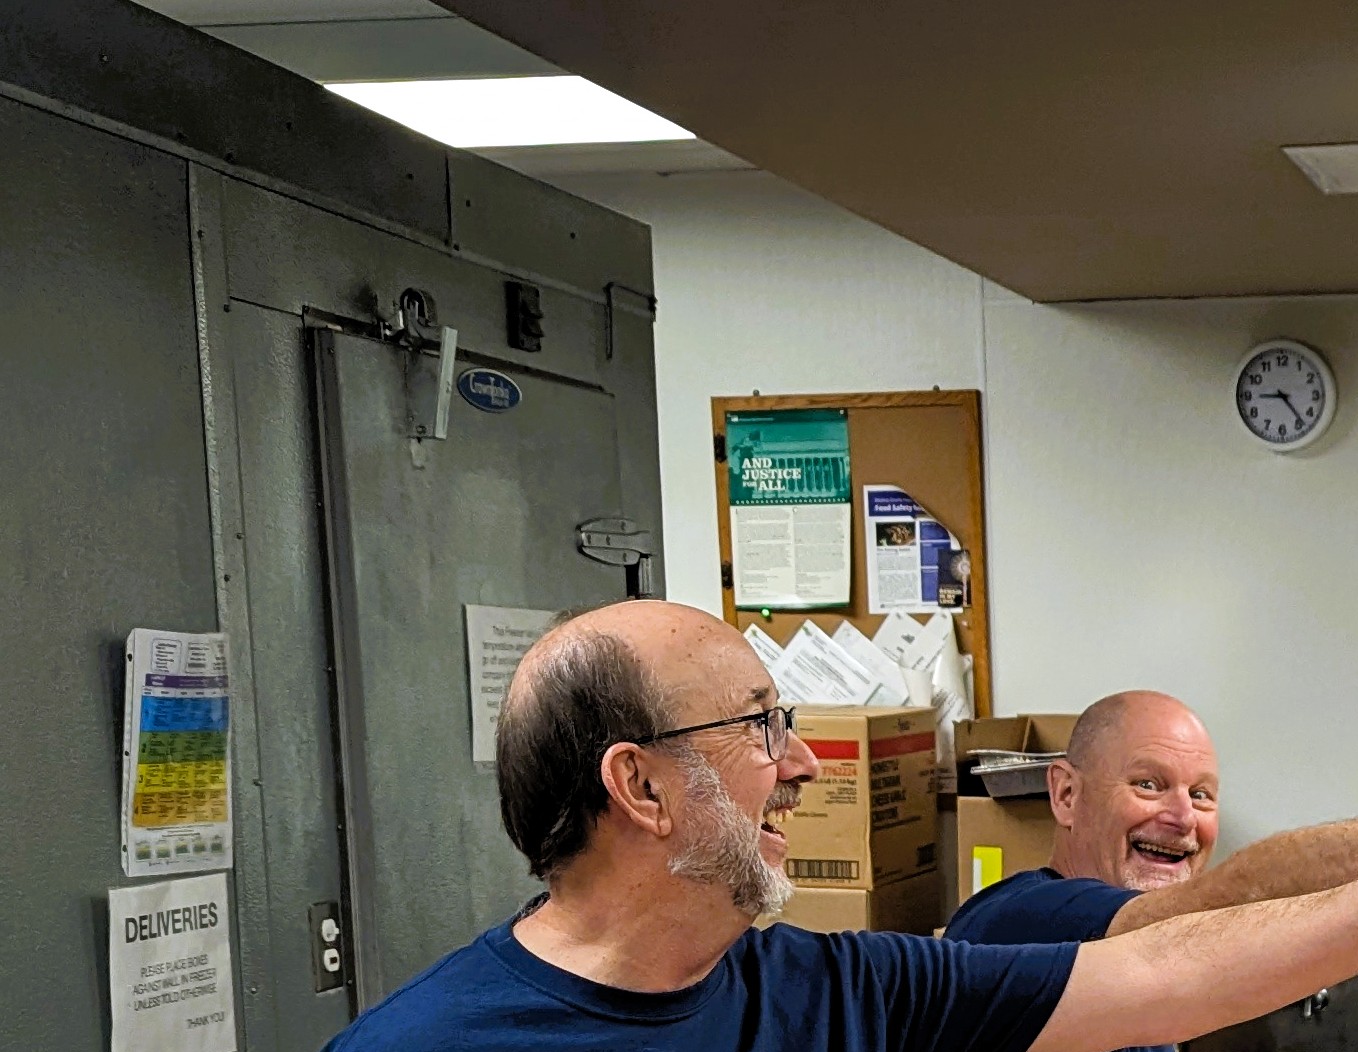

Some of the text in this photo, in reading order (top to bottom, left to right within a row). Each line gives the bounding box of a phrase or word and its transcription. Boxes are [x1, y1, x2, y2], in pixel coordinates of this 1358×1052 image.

[1276, 355, 1289, 366] 12
[1262, 361, 1271, 372] 11
[1249, 375, 1262, 385] 10
[742, 457, 772, 468] AND
[742, 468, 802, 480] JUSTICE
[758, 480, 786, 491] ALL
[125, 902, 218, 944] DELIVERIES
